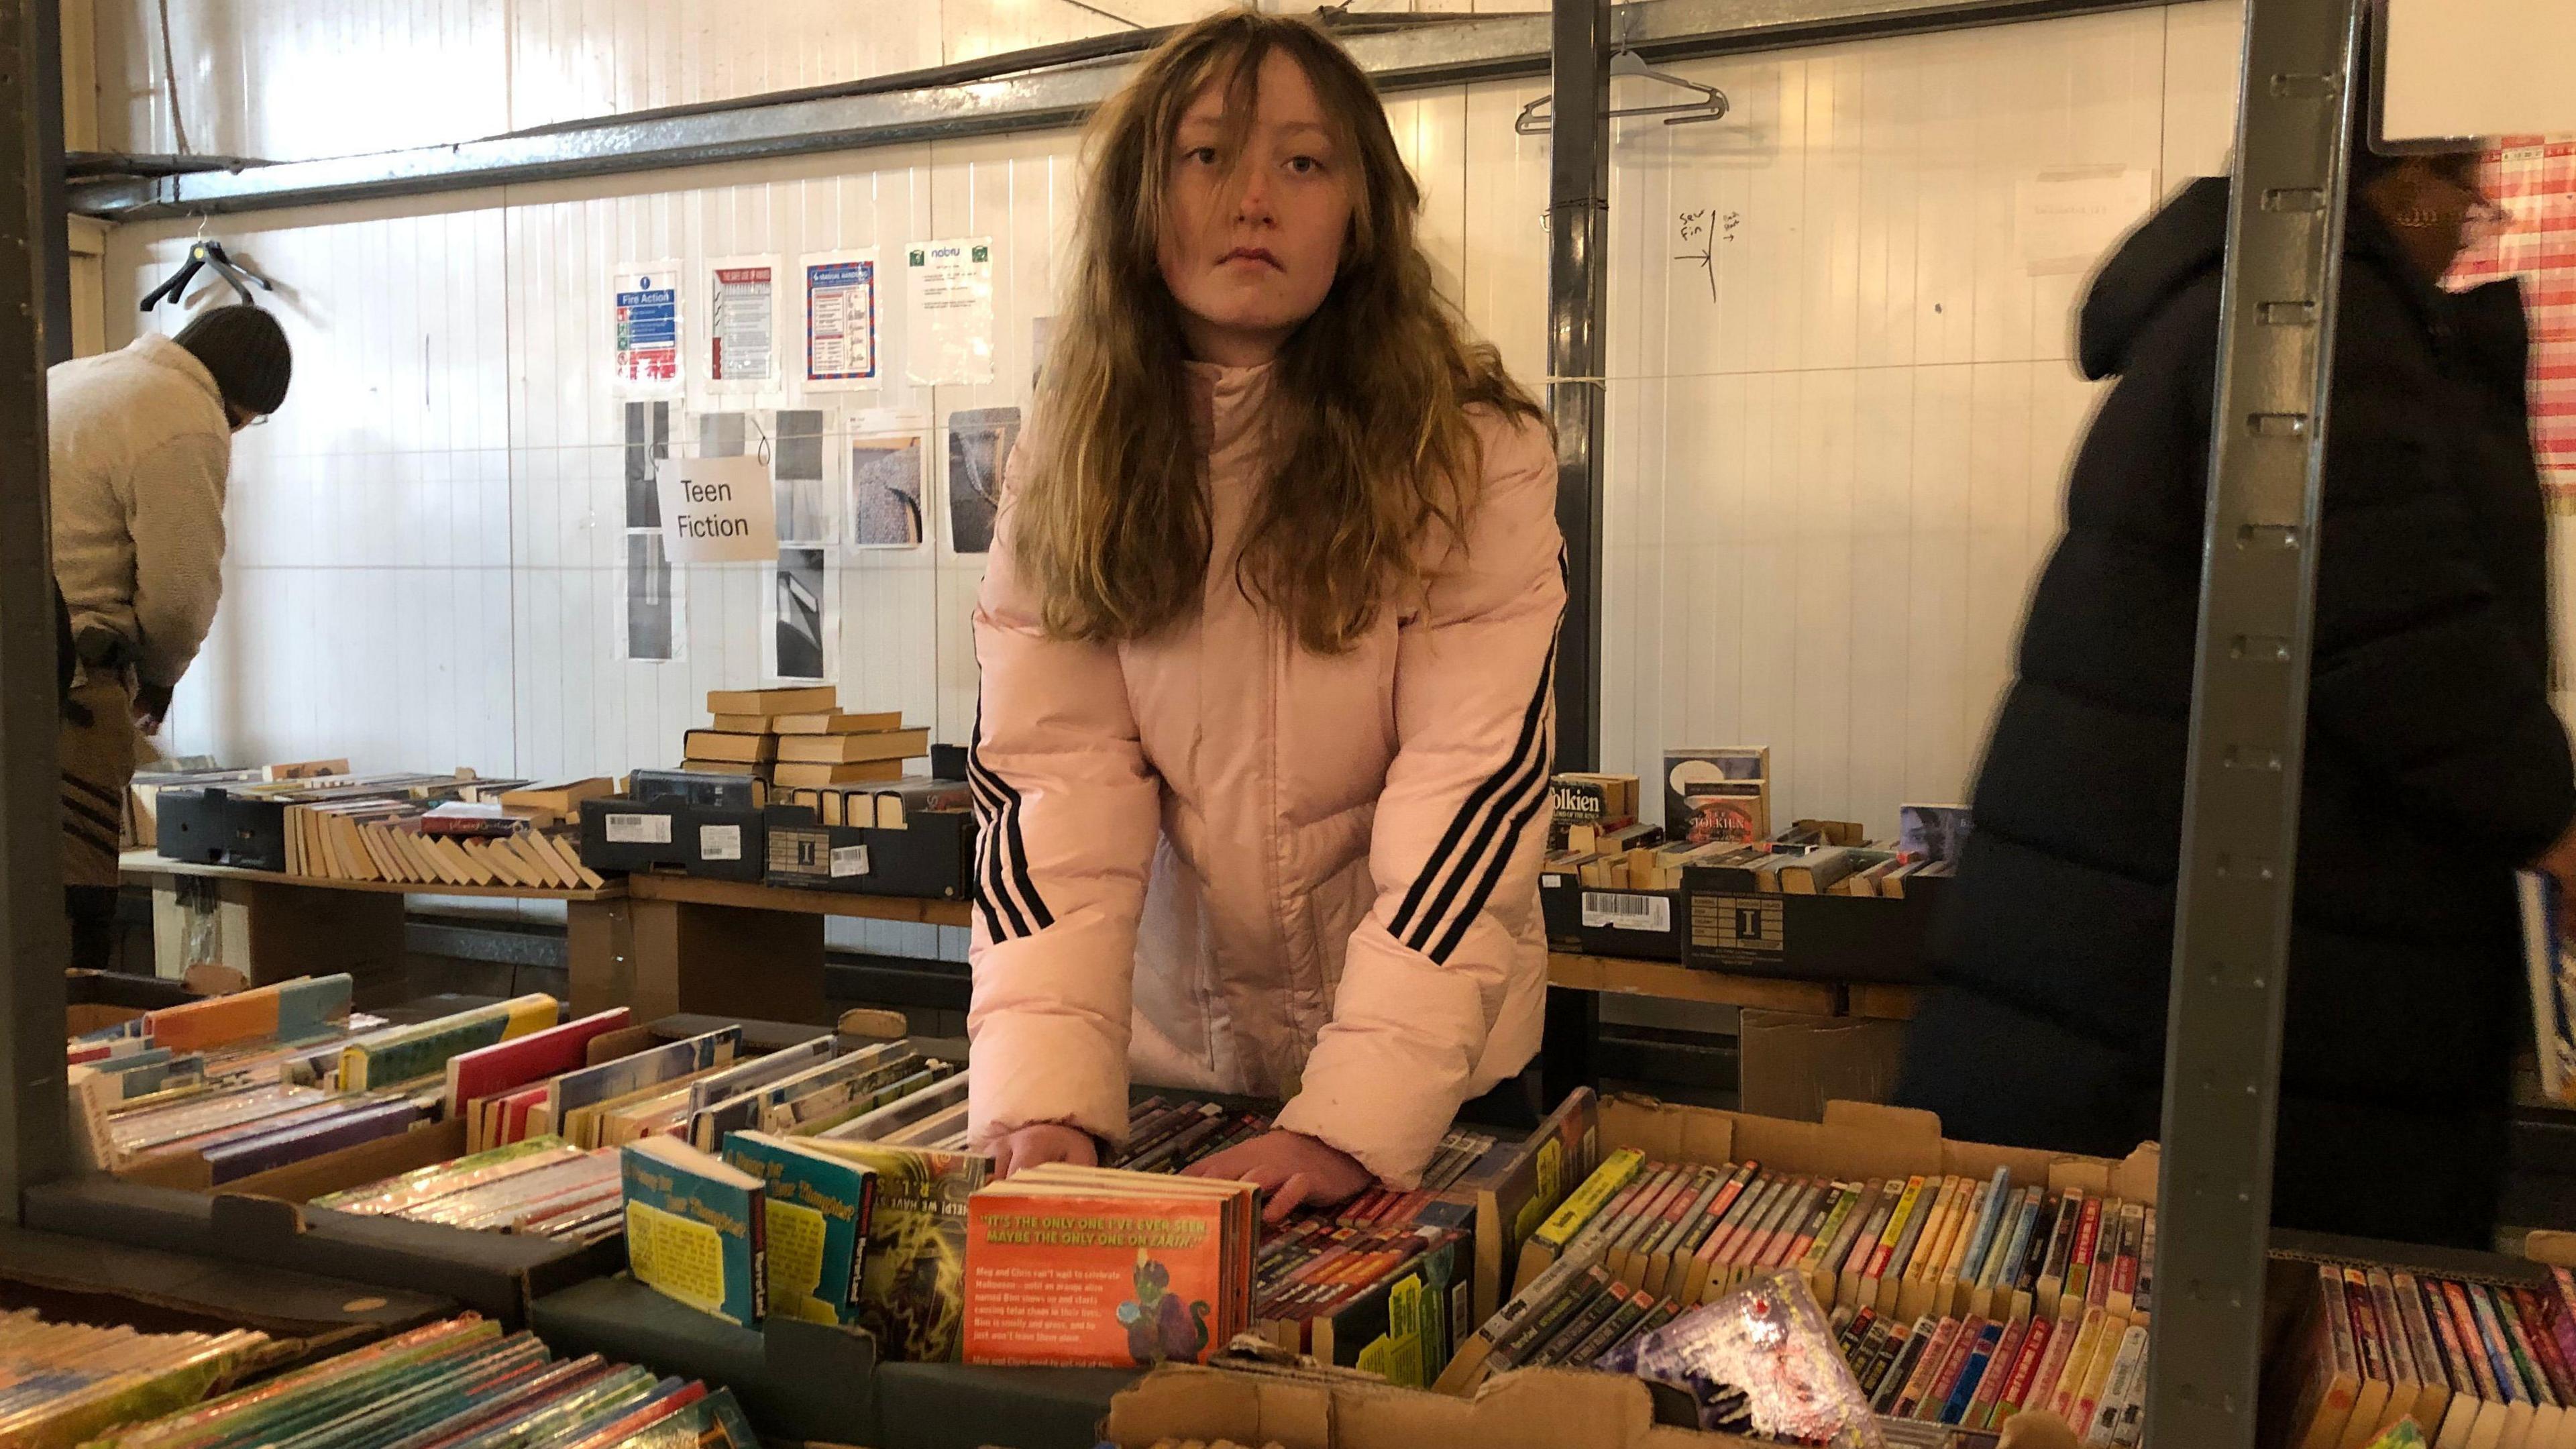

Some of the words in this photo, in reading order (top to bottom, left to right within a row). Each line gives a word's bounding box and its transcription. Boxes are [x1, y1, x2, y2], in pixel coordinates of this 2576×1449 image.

[623, 294, 640, 305] Fire
[641, 290, 669, 303] Action
[680, 480, 731, 502] Teen
[678, 514, 748, 537] Fiction
[1015, 1216, 1038, 1228] THE
[1042, 1217, 1075, 1228] ONLY
[1078, 1218, 1104, 1229] ONE
[1138, 1219, 1170, 1230] EVER
[987, 1231, 1030, 1243] MAYBE
[1034, 1232, 1057, 1243] THE
[1061, 1233, 1095, 1244] ONLY
[1098, 1234, 1124, 1245] ONE
[1128, 1234, 1148, 1246] ON
[996, 1267, 1010, 1277] and
